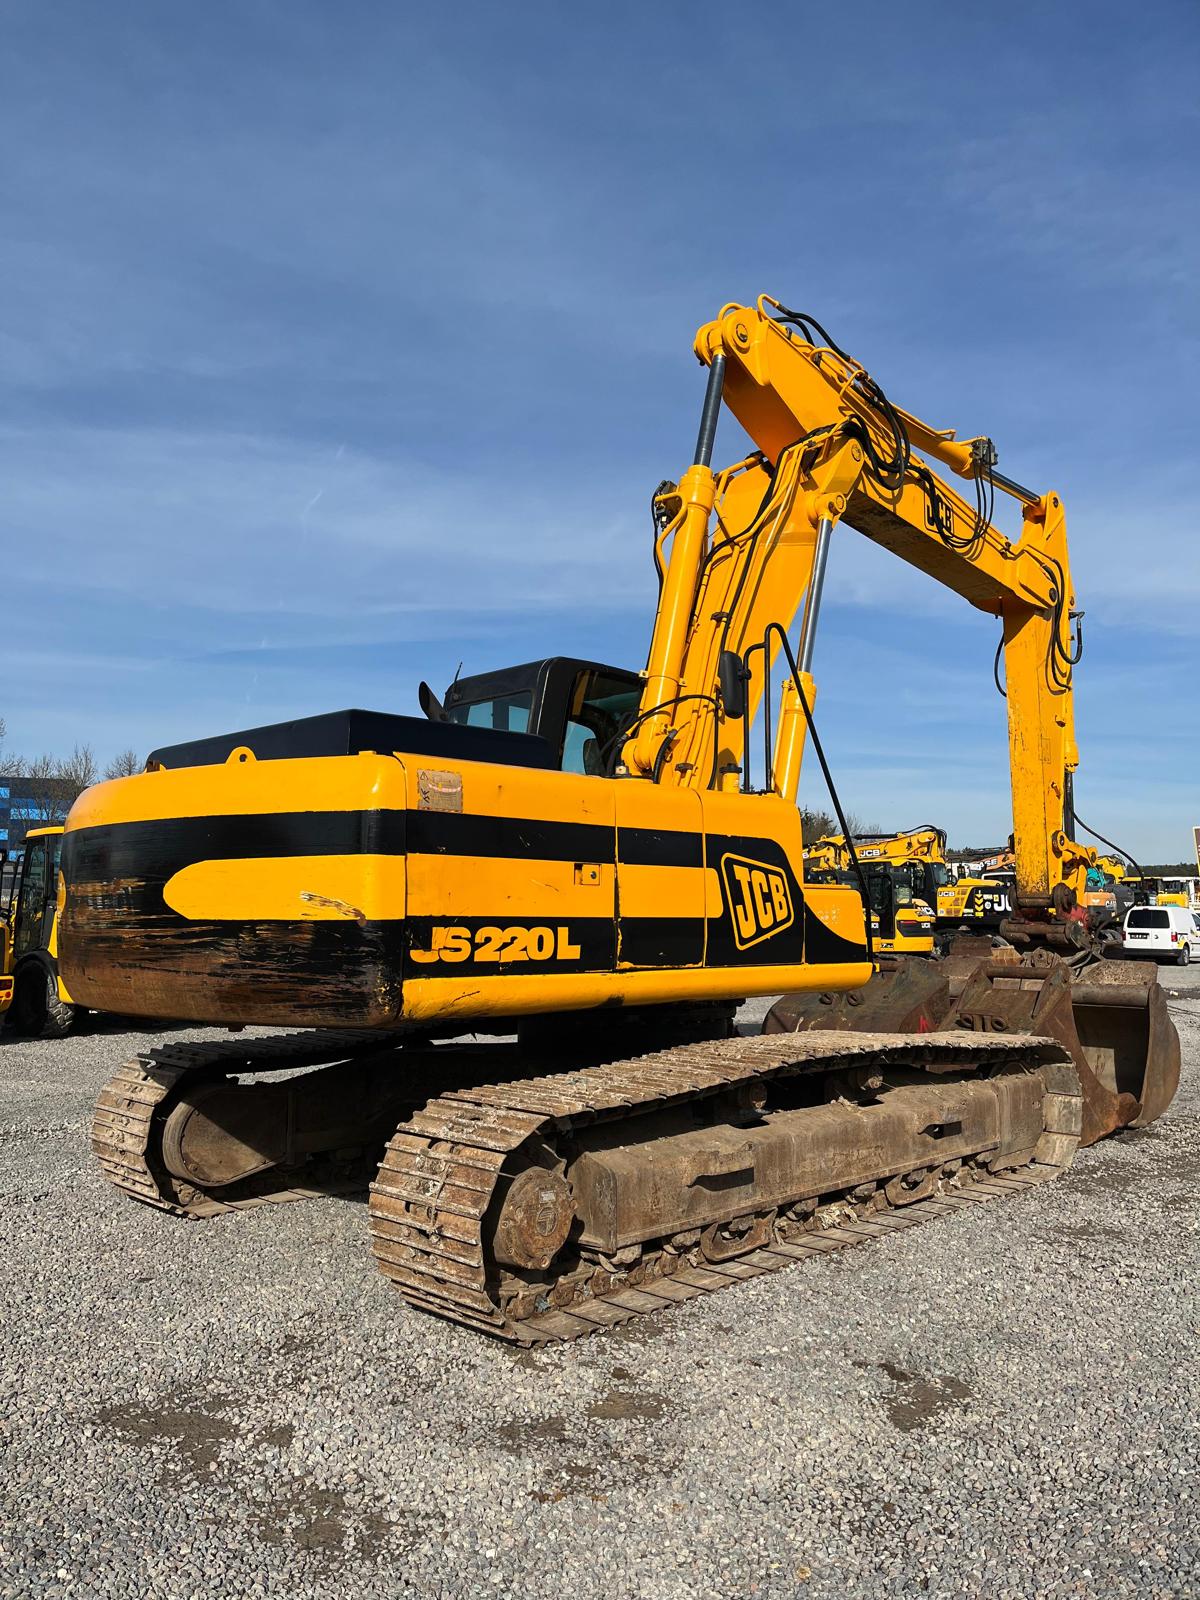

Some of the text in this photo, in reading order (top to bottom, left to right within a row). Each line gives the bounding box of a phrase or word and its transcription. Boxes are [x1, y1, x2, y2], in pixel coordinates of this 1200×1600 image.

[860, 849, 881, 857] JCB
[732, 863, 788, 939] JCB
[409, 925, 581, 964] JS220L
